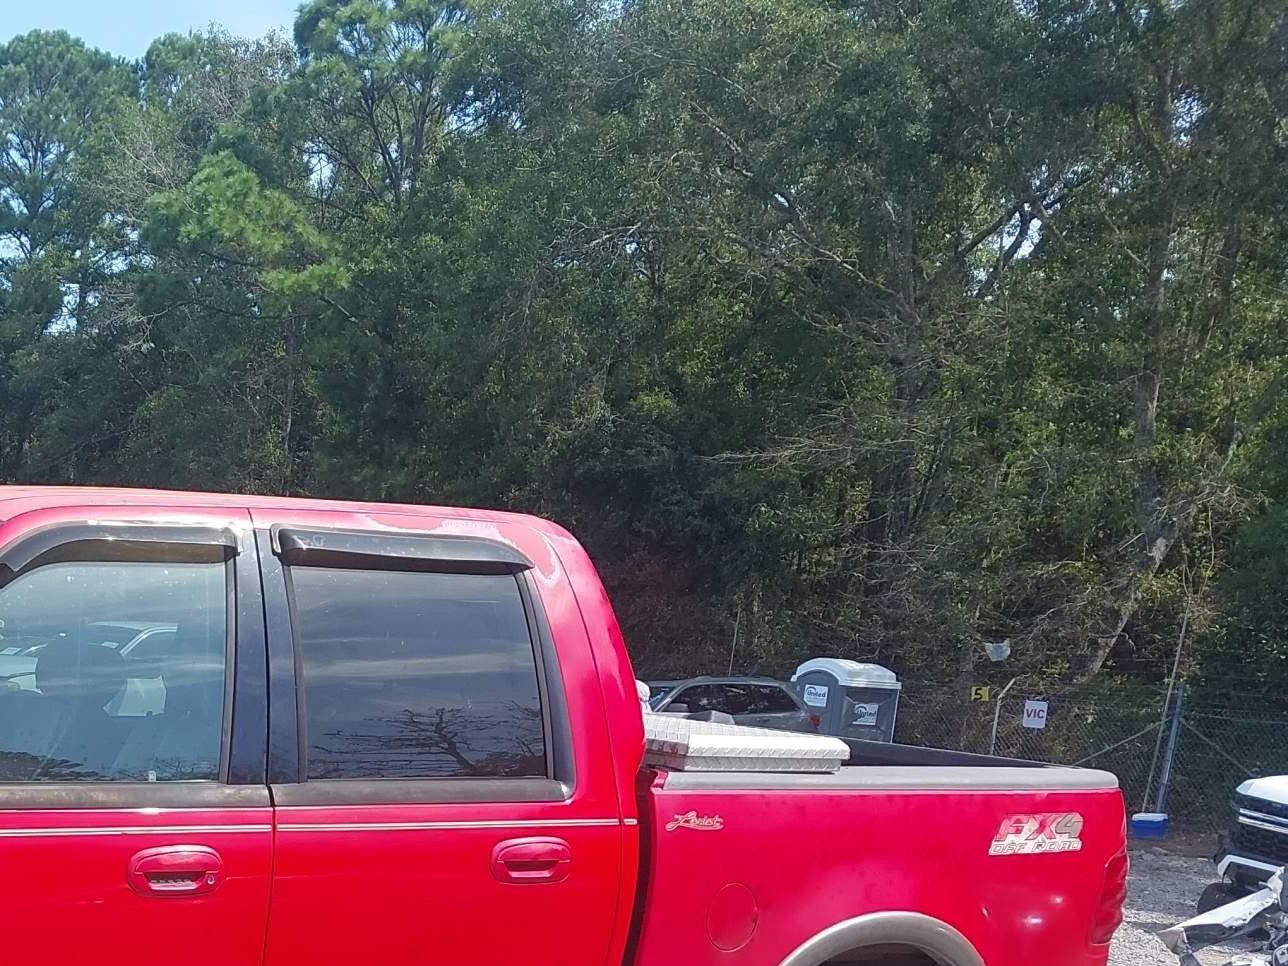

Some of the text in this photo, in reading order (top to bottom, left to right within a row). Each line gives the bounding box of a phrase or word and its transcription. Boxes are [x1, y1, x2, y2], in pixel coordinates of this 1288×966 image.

[973, 687, 984, 700] 5
[1025, 708, 1046, 719] VIC
[993, 811, 1084, 842] FX4
